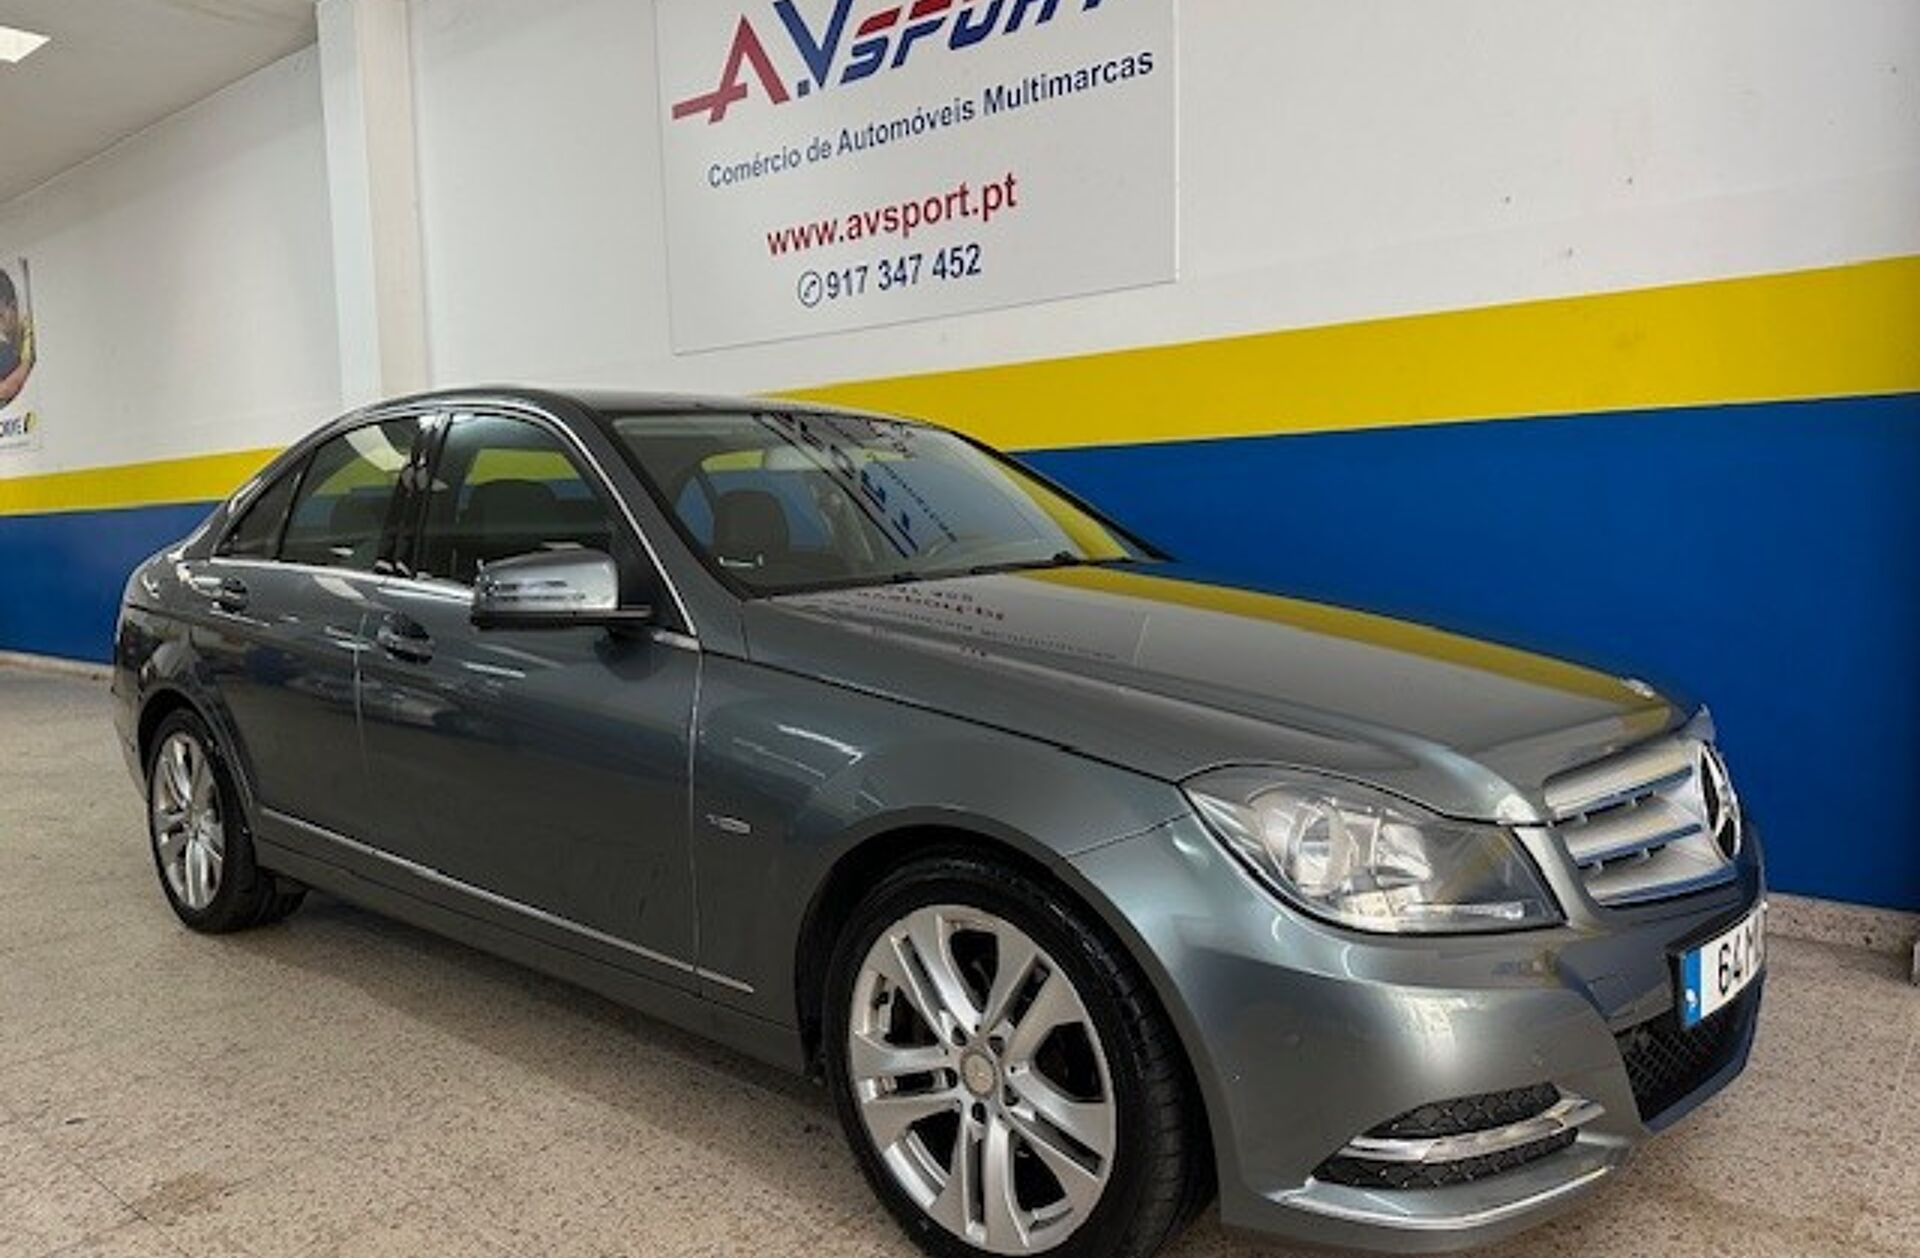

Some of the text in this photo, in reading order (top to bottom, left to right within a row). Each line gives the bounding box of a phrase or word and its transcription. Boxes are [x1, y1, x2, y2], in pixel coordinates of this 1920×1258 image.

[708, 51, 1154, 189] Comércio de Automóveis Multimarcas
[766, 171, 1018, 256] www.avsport.pt
[825, 242, 982, 300] 917 347 452
